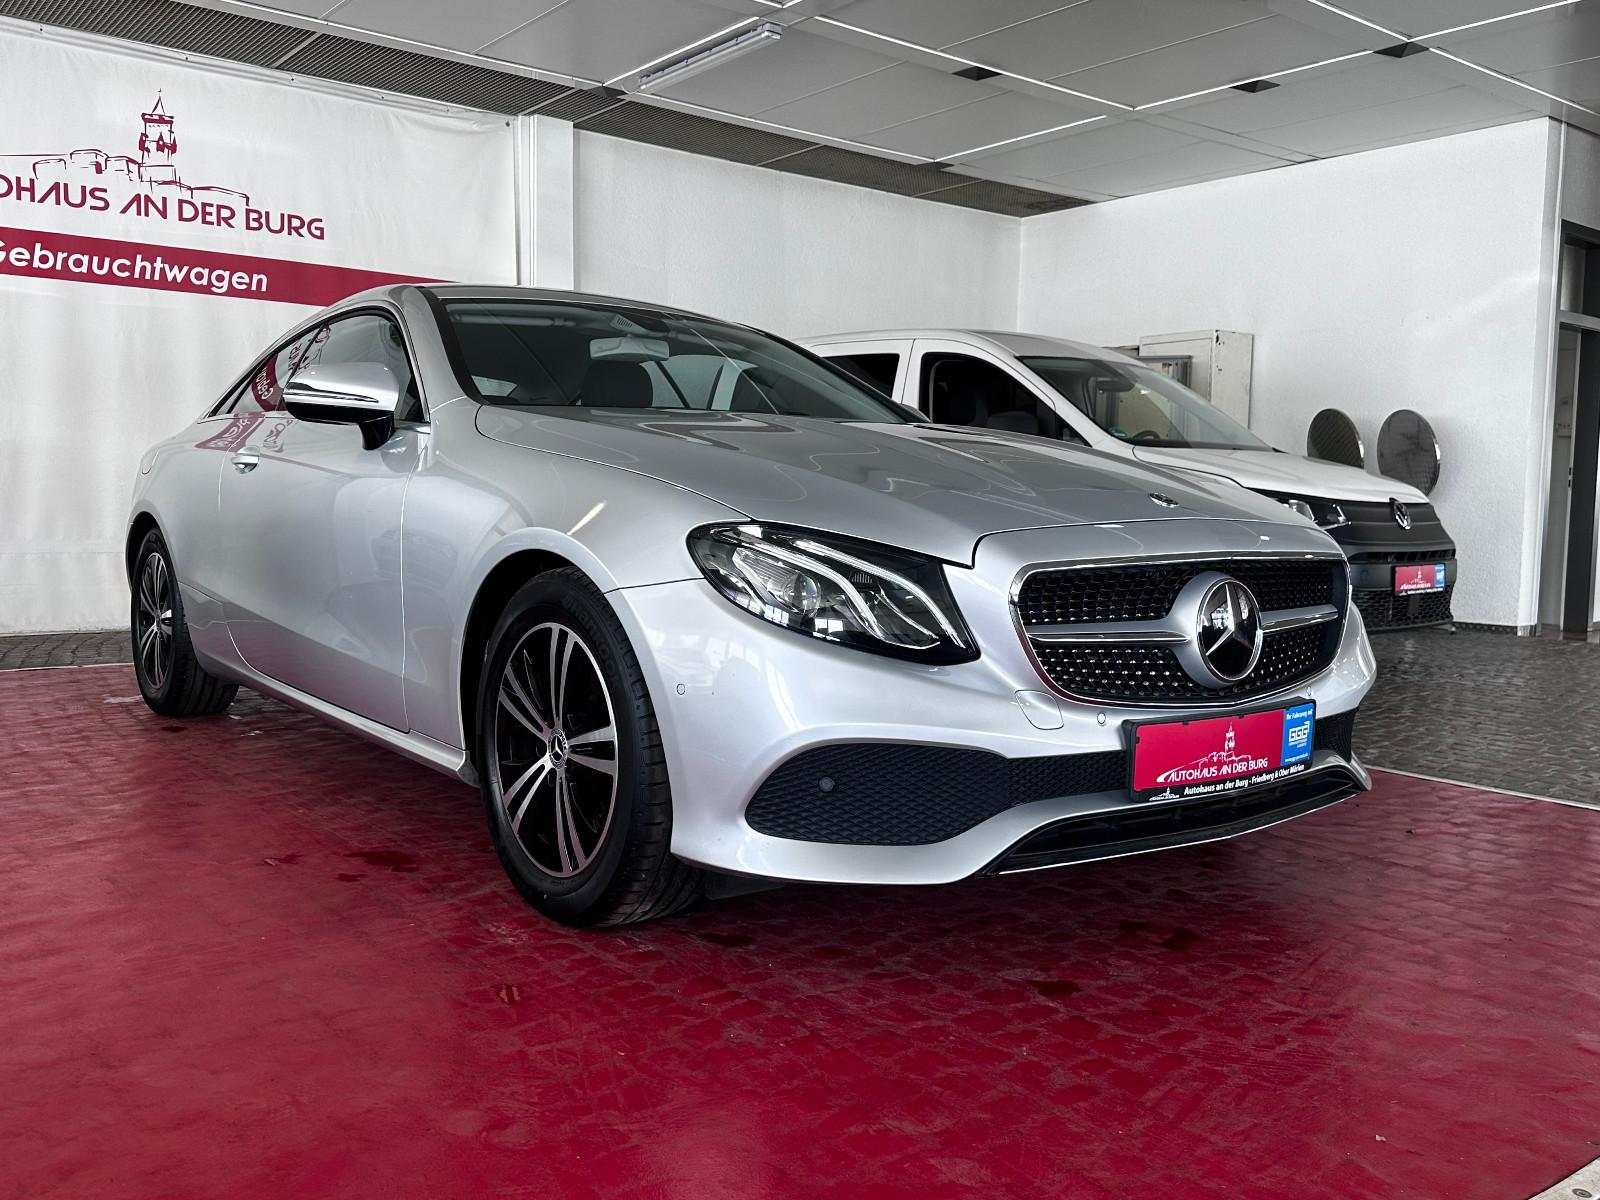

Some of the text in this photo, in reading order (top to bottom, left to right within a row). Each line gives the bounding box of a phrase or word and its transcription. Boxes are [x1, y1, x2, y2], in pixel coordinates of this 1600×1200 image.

[119, 193, 168, 220] AN
[178, 198, 236, 229] DER
[245, 207, 325, 241] BURG
[1167, 758, 1268, 783] AUTOHAUS AN DER BURG
[1183, 784, 1215, 796] Autohaus
[1216, 783, 1224, 791] an
[1224, 781, 1235, 789] der
[1235, 778, 1248, 788] Burg
[1251, 773, 1275, 785] Friedberg
